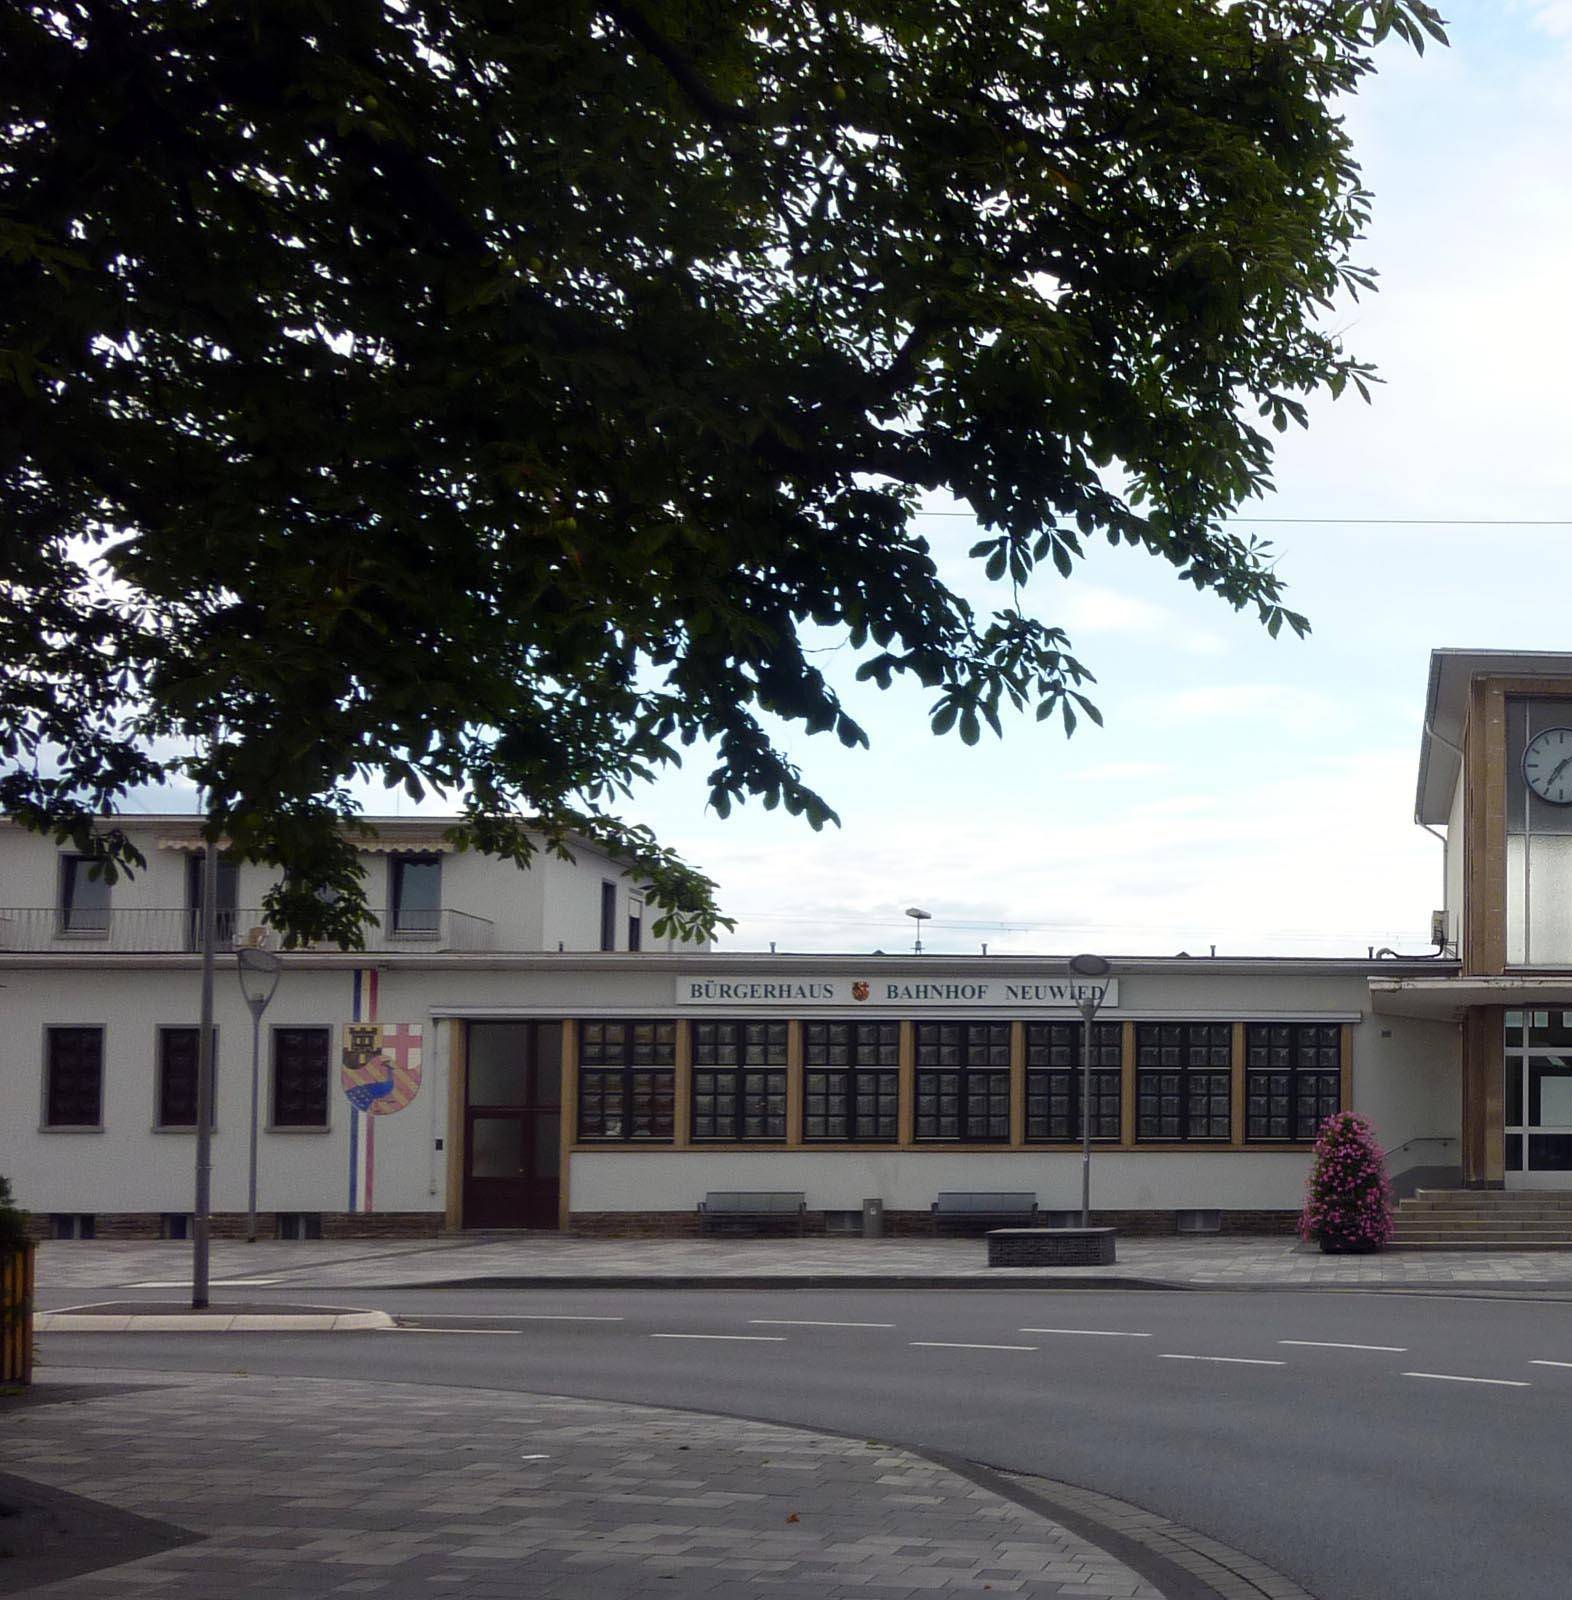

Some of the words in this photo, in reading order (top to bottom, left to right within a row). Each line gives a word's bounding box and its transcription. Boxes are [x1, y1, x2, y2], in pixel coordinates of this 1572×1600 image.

[690, 980, 834, 999] BÜRGERHAUS
[887, 984, 989, 1000] BAHNHOF
[1006, 985, 1105, 1001] NEUWIED
